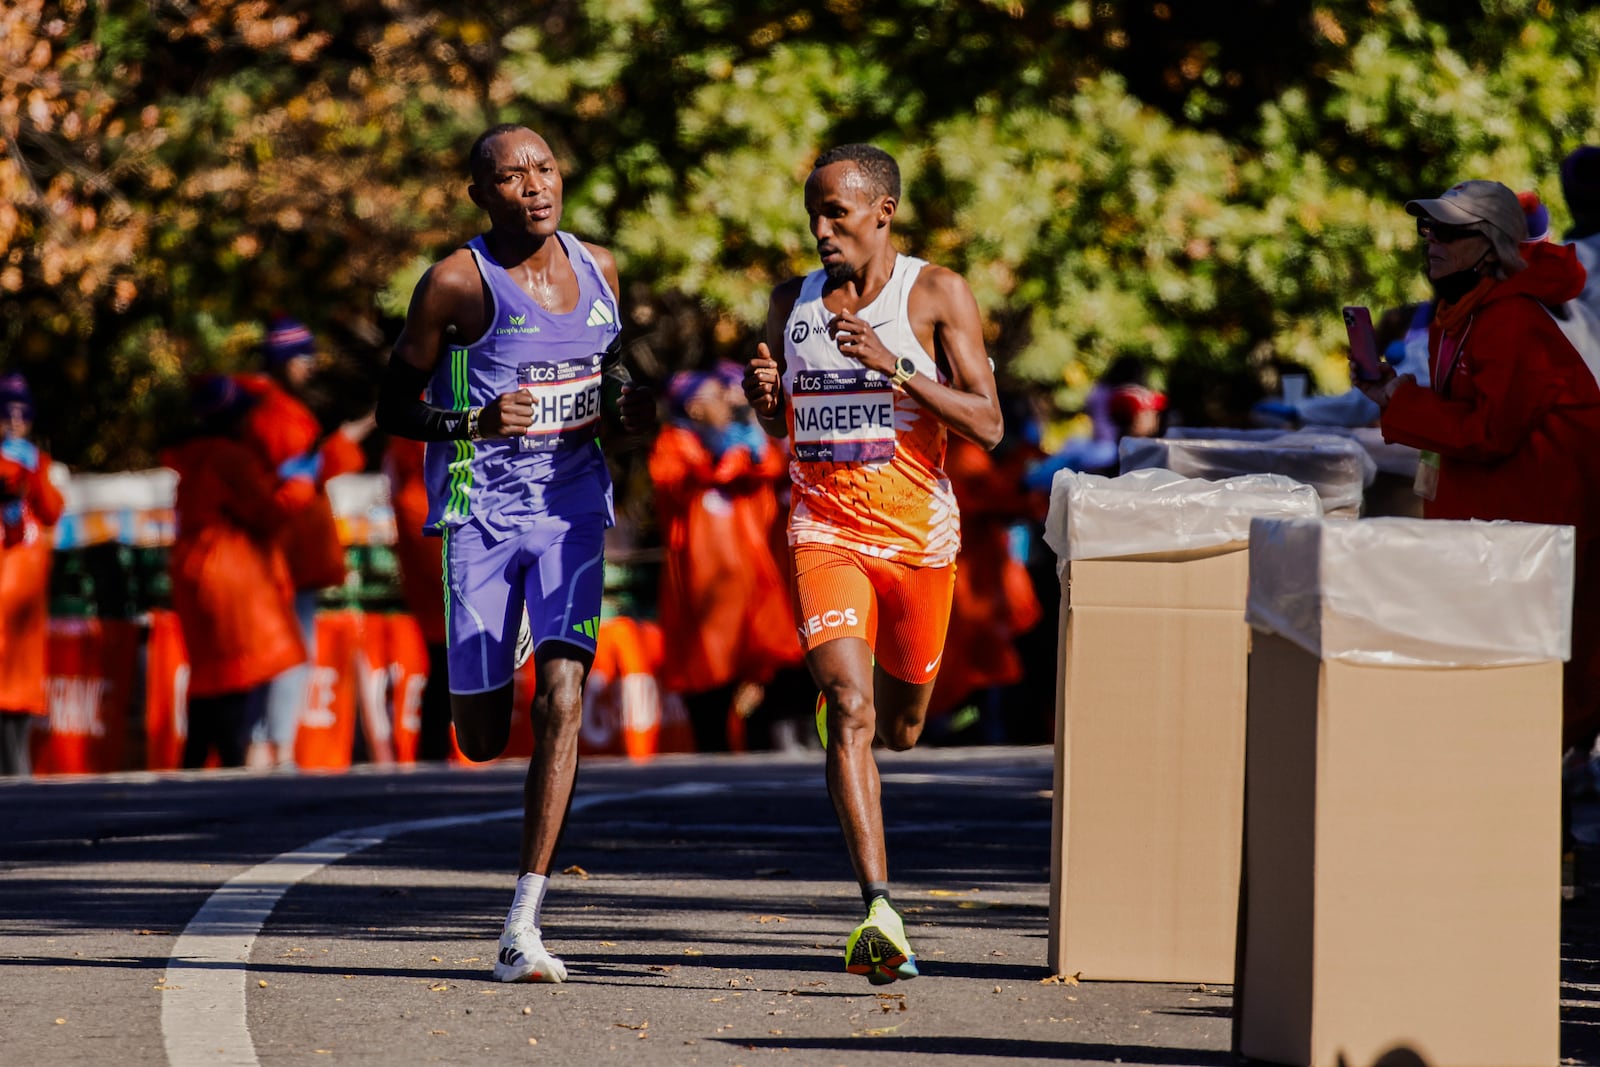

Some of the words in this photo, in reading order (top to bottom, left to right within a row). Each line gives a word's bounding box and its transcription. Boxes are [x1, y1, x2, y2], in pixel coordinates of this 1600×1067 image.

[530, 365, 555, 381] tcs
[801, 374, 821, 391] tcs
[794, 404, 892, 431] NAGEEYE
